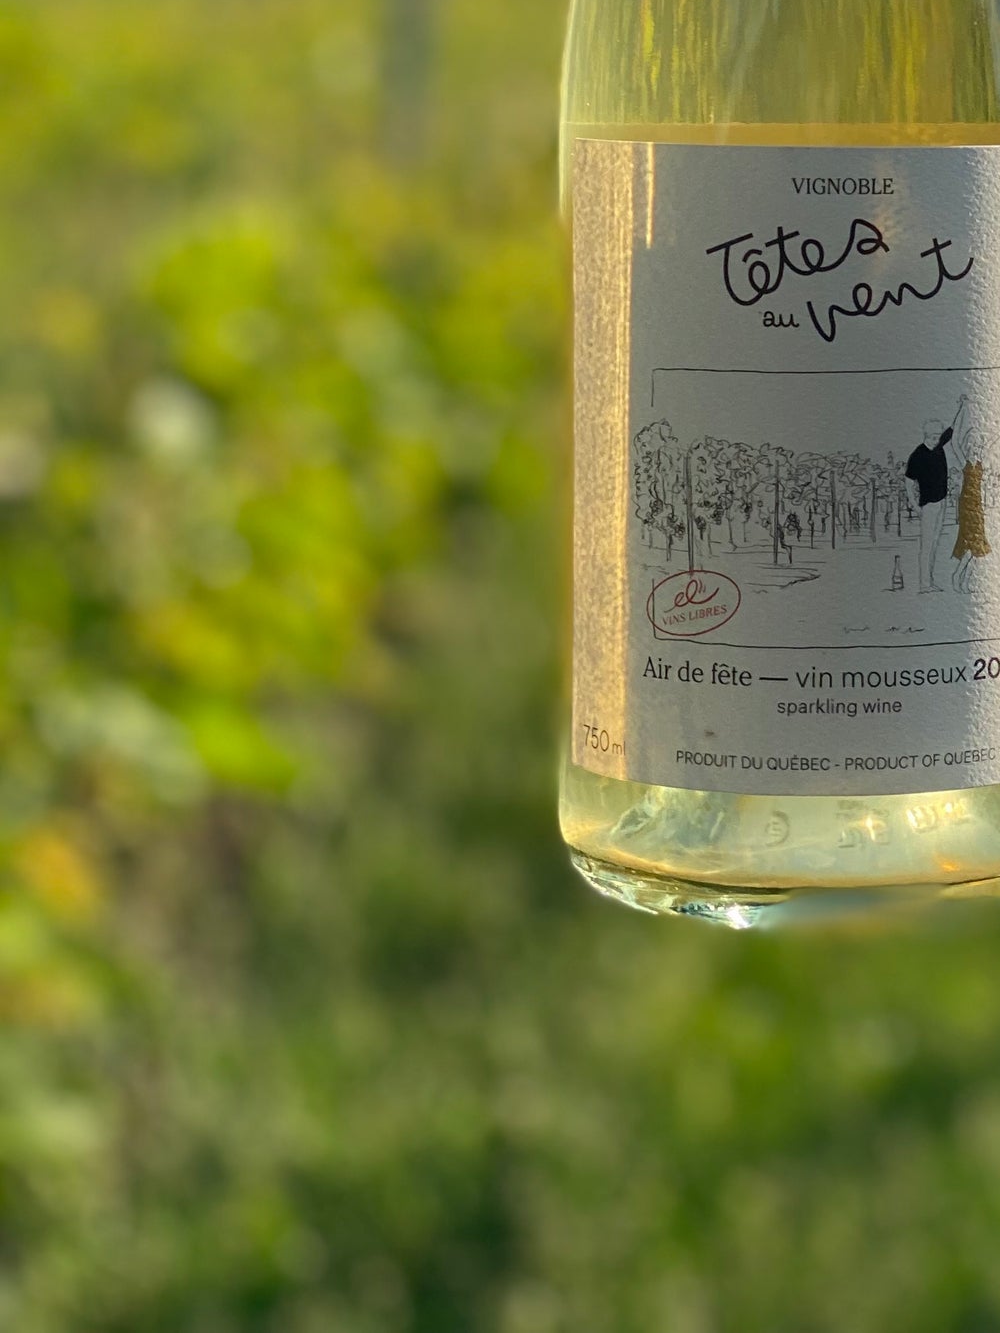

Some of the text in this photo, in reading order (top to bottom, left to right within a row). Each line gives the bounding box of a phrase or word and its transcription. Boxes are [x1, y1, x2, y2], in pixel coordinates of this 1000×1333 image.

[791, 177, 895, 196] VIGNOBLE
[706, 218, 890, 306] Têtes
[762, 237, 975, 343] au vent
[662, 604, 728, 626] VINS LIBRES
[642, 656, 672, 680] Air
[677, 660, 704, 683] de
[711, 662, 753, 686] fête
[796, 666, 832, 688] vin
[842, 665, 968, 688] mousseux
[776, 698, 903, 717] sparkling wine
[583, 724, 626, 756] 750 ml
[676, 750, 738, 768] PRODUIT
[741, 755, 763, 770] DU
[766, 755, 831, 771] QUÉBEC
[844, 755, 919, 771] PRODUCT
[921, 753, 941, 768] OF
